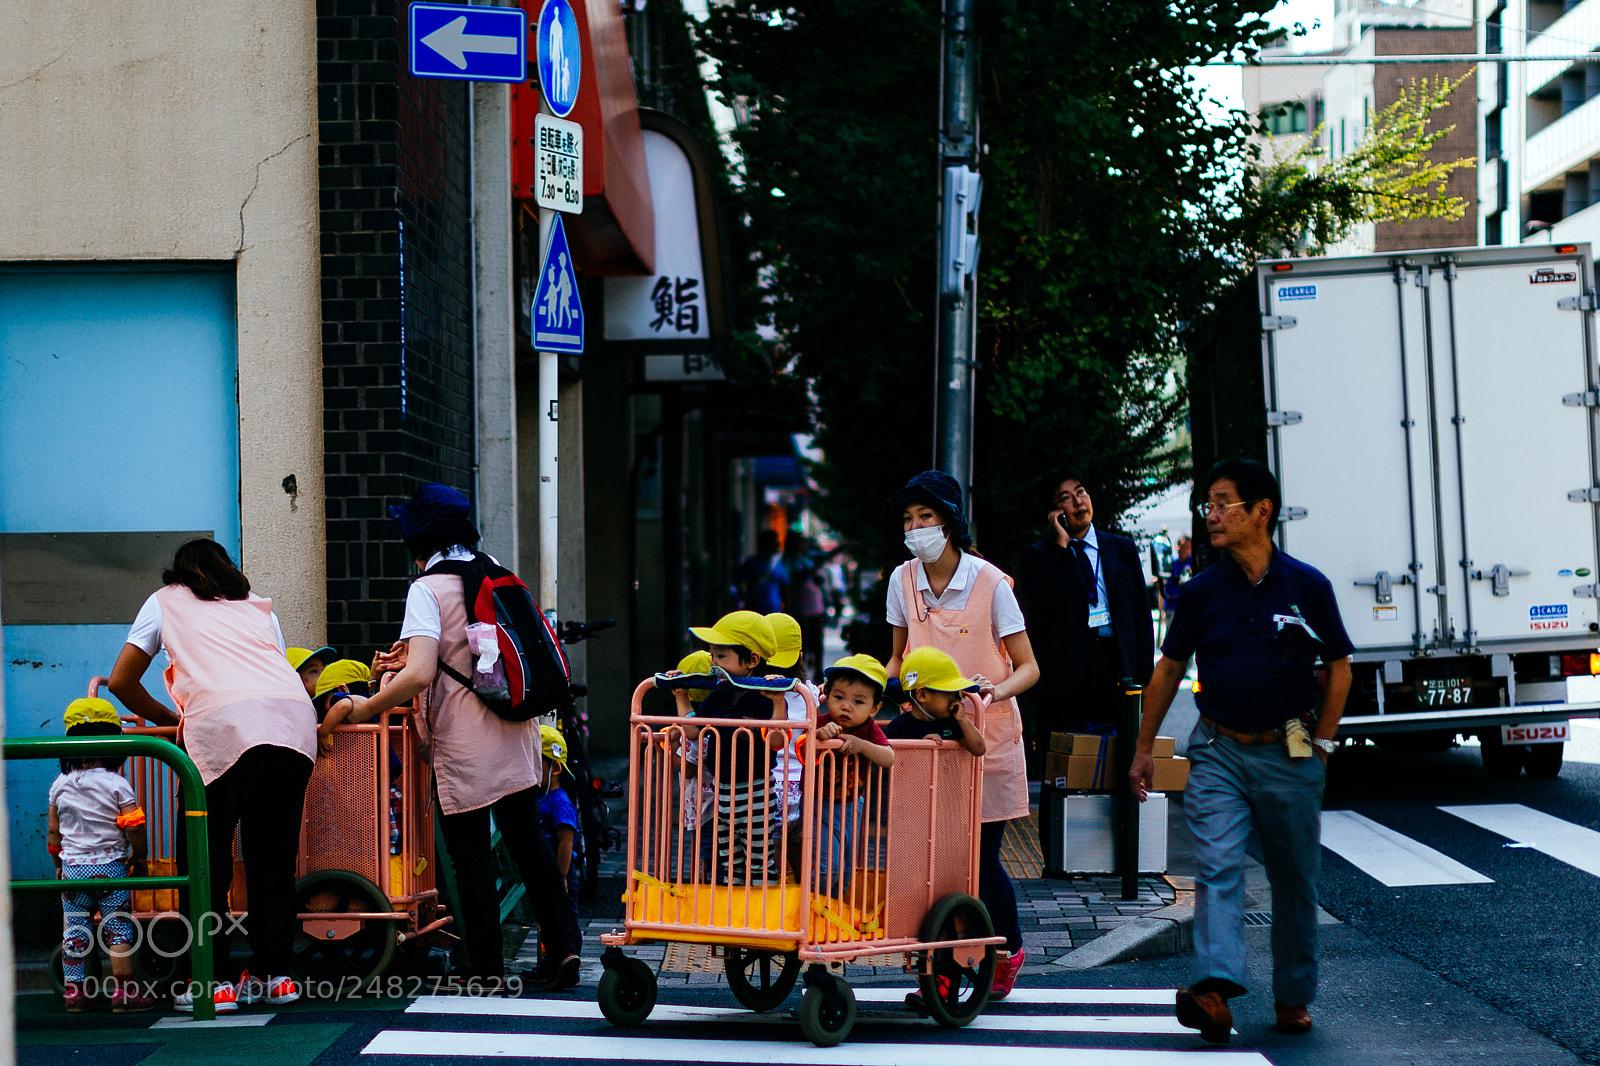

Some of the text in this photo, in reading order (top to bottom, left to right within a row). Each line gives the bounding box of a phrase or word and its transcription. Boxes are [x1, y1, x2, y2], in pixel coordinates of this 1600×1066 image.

[541, 126, 579, 155] 自転車を除く
[649, 275, 699, 335] 鮨
[1530, 620, 1569, 631] ISUZU
[1447, 678, 1460, 688] 101
[1427, 687, 1471, 706] 77-87
[1507, 726, 1566, 741] ISUZU
